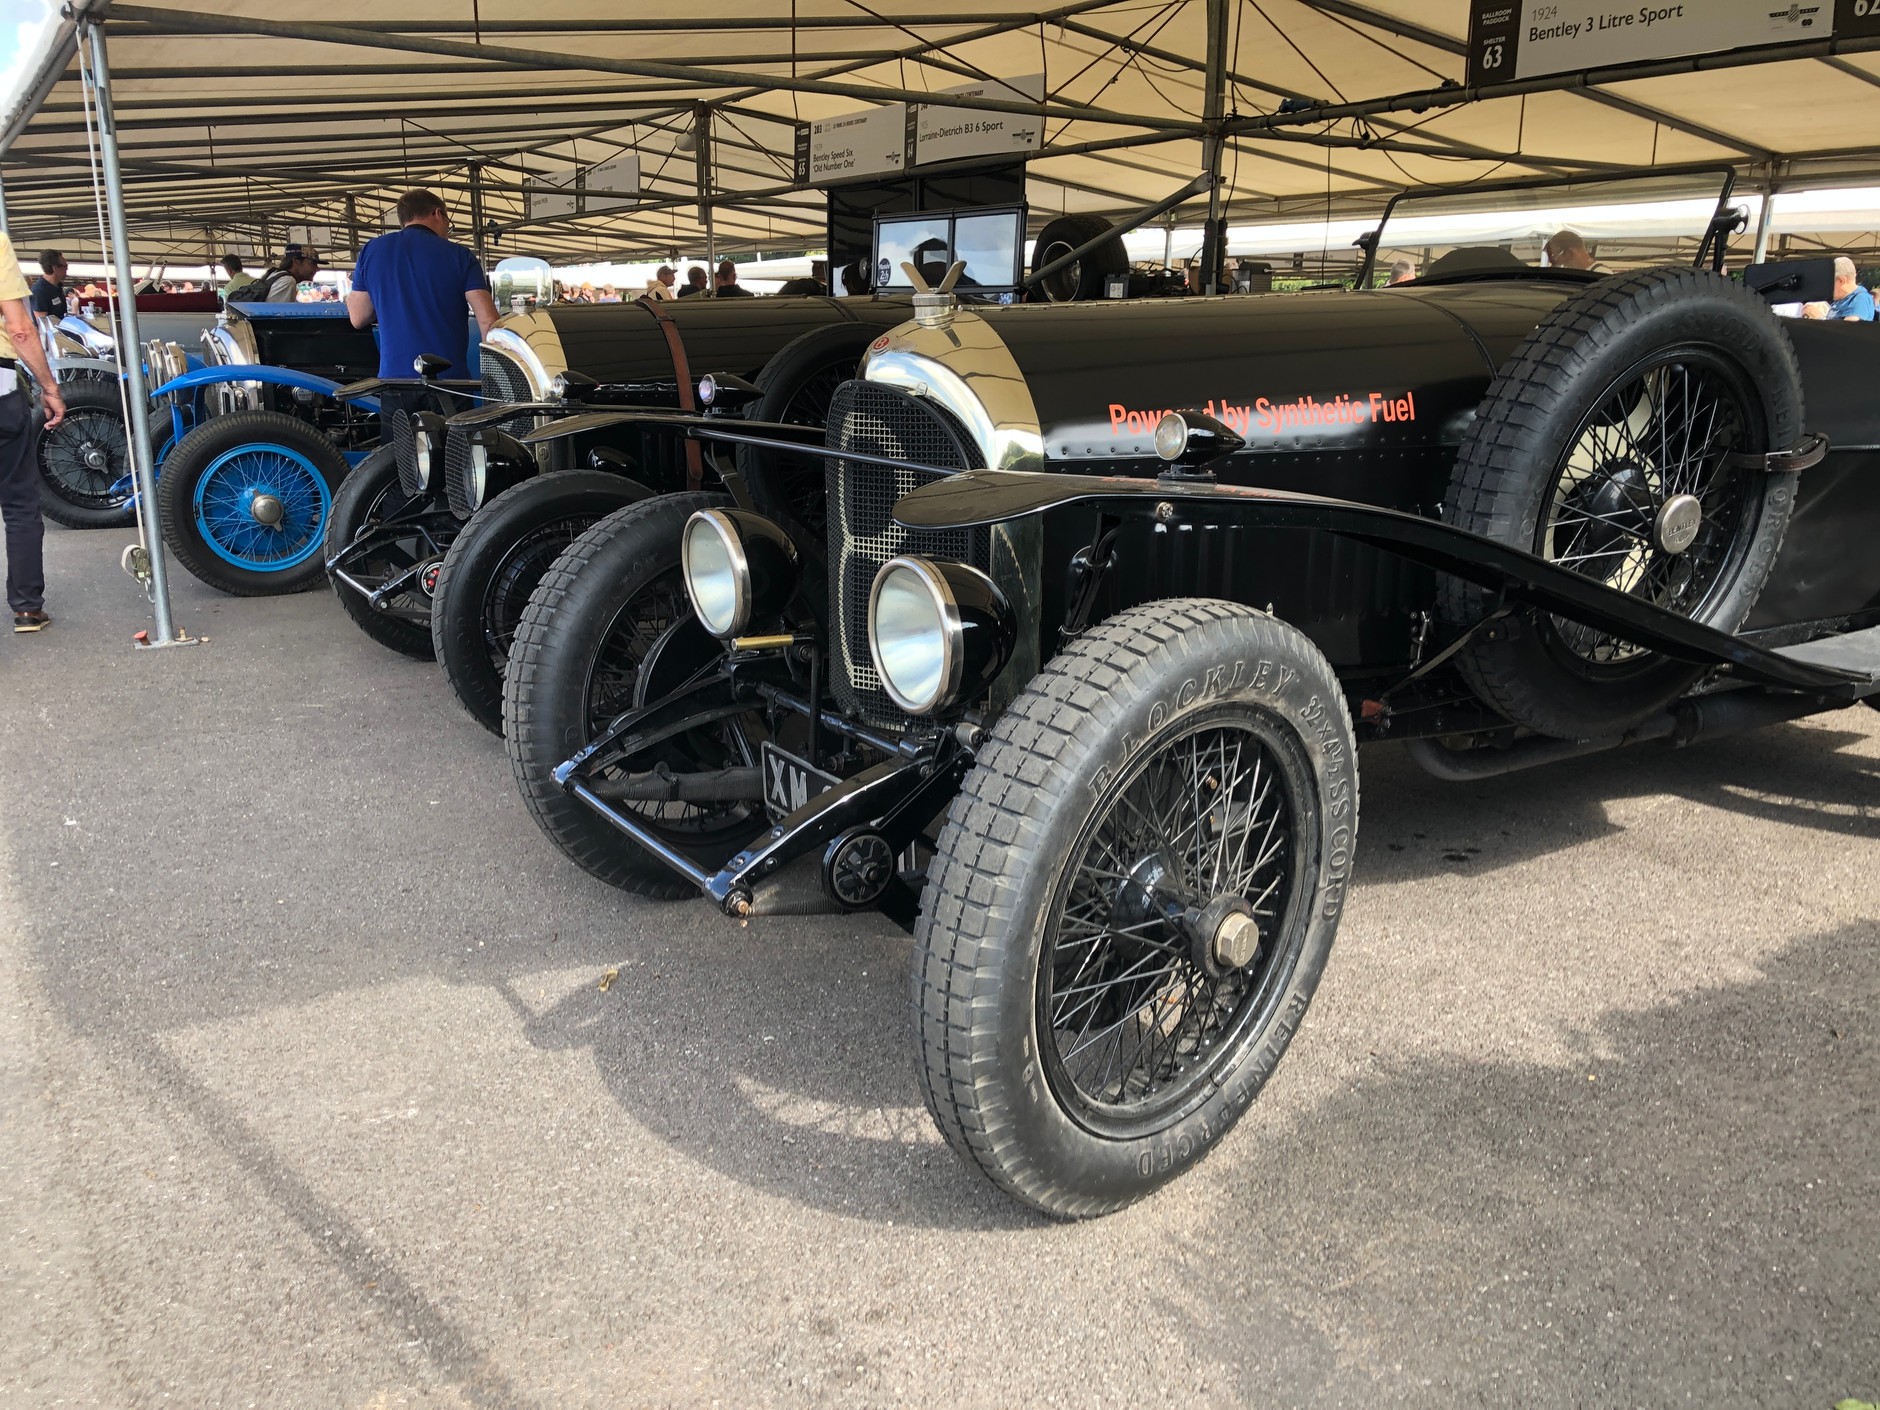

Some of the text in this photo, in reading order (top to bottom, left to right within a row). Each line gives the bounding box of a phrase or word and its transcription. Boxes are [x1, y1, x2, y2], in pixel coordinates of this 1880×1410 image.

[1482, 8, 1512, 20] BALLROOM
[1483, 16, 1510, 26] PADDOCK
[1532, 6, 1558, 21] 1924
[1529, 4, 1684, 42] Bentley 3 Litre Sport
[1483, 36, 1506, 45] SHELTER
[1483, 45, 1503, 70] 63
[965, 122, 974, 134] B3
[975, 122, 980, 133] 6
[982, 121, 1004, 135] Sport
[813, 148, 854, 163] Bentley Speed Six
[824, 162, 843, 171] Number
[1221, 399, 1250, 436] by
[1256, 394, 1365, 434] Synthetic
[1369, 391, 1416, 423] Fuel
[1088, 660, 1296, 800] BLOCKLEY
